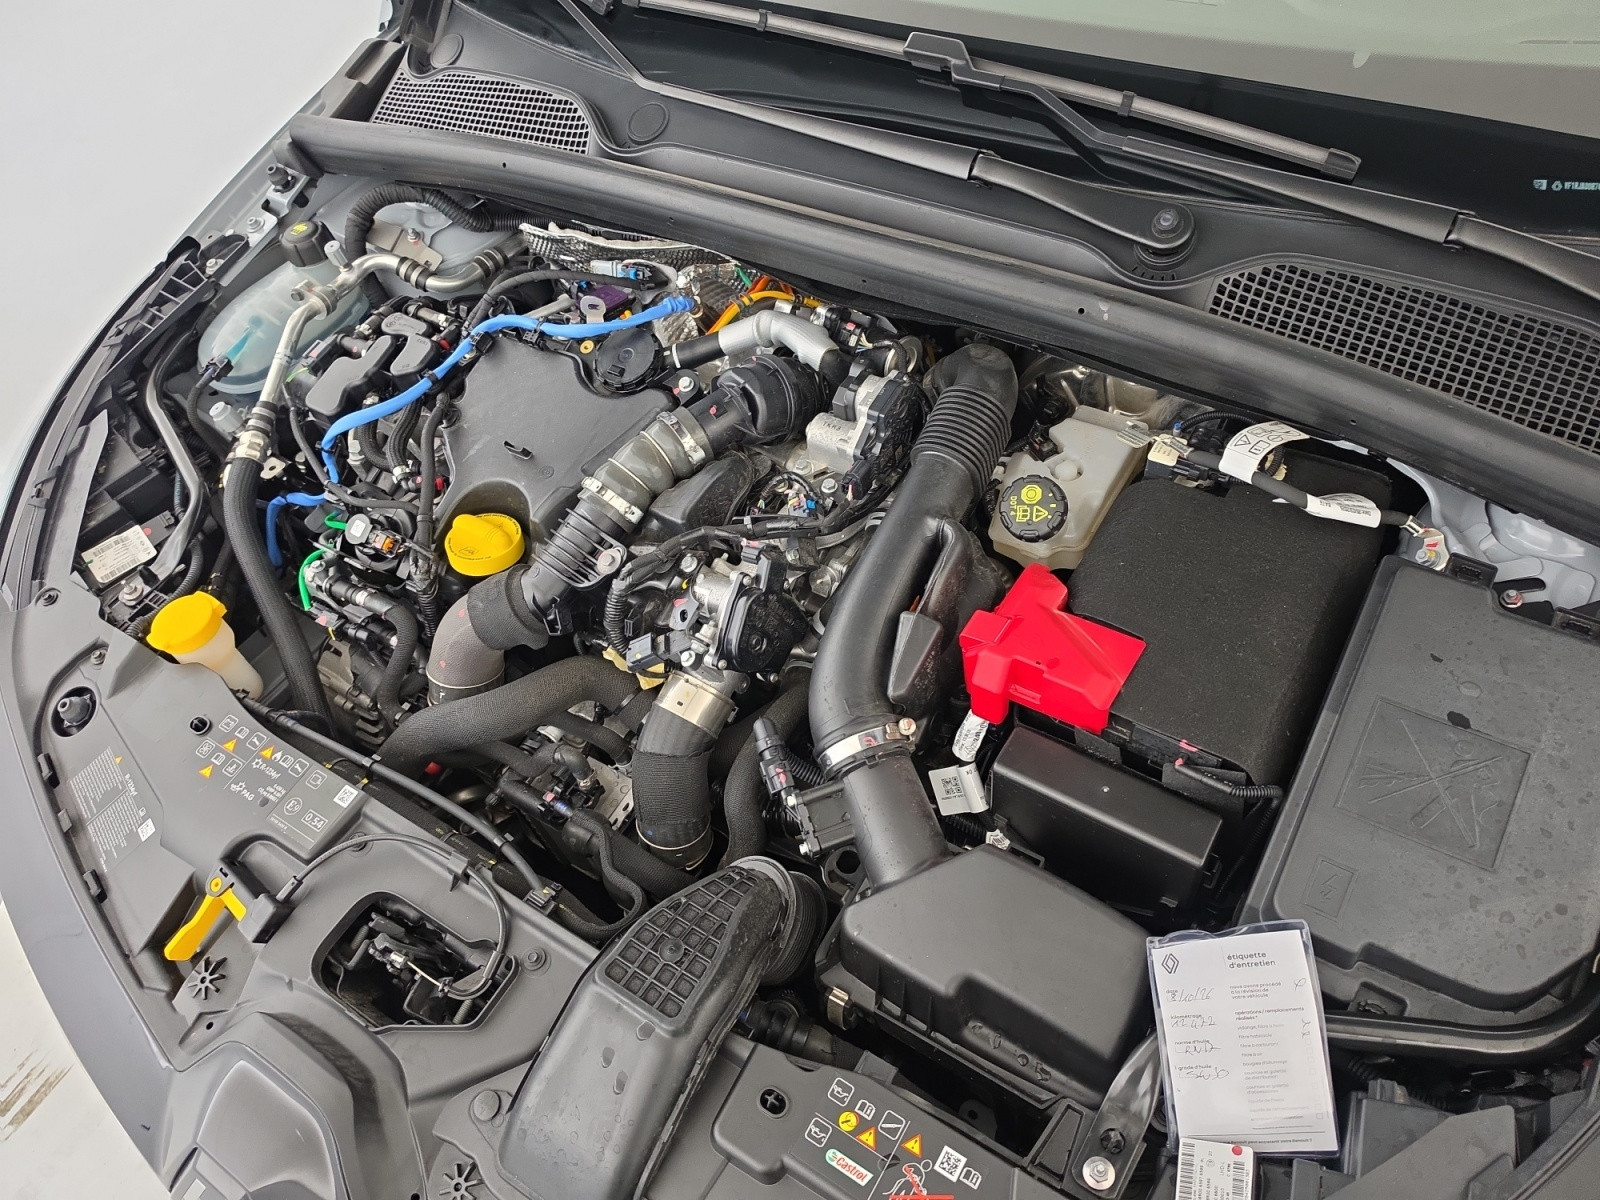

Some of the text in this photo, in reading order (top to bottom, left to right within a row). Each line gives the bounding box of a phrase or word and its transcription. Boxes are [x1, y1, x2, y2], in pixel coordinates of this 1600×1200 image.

[1010, 496, 1018, 510] DOT
[242, 789, 255, 801] PAG
[304, 812, 325, 829] 0,54
[1227, 952, 1267, 961] étiquette
[1228, 960, 1276, 969] d'entretien
[835, 1156, 868, 1182] Castrol
